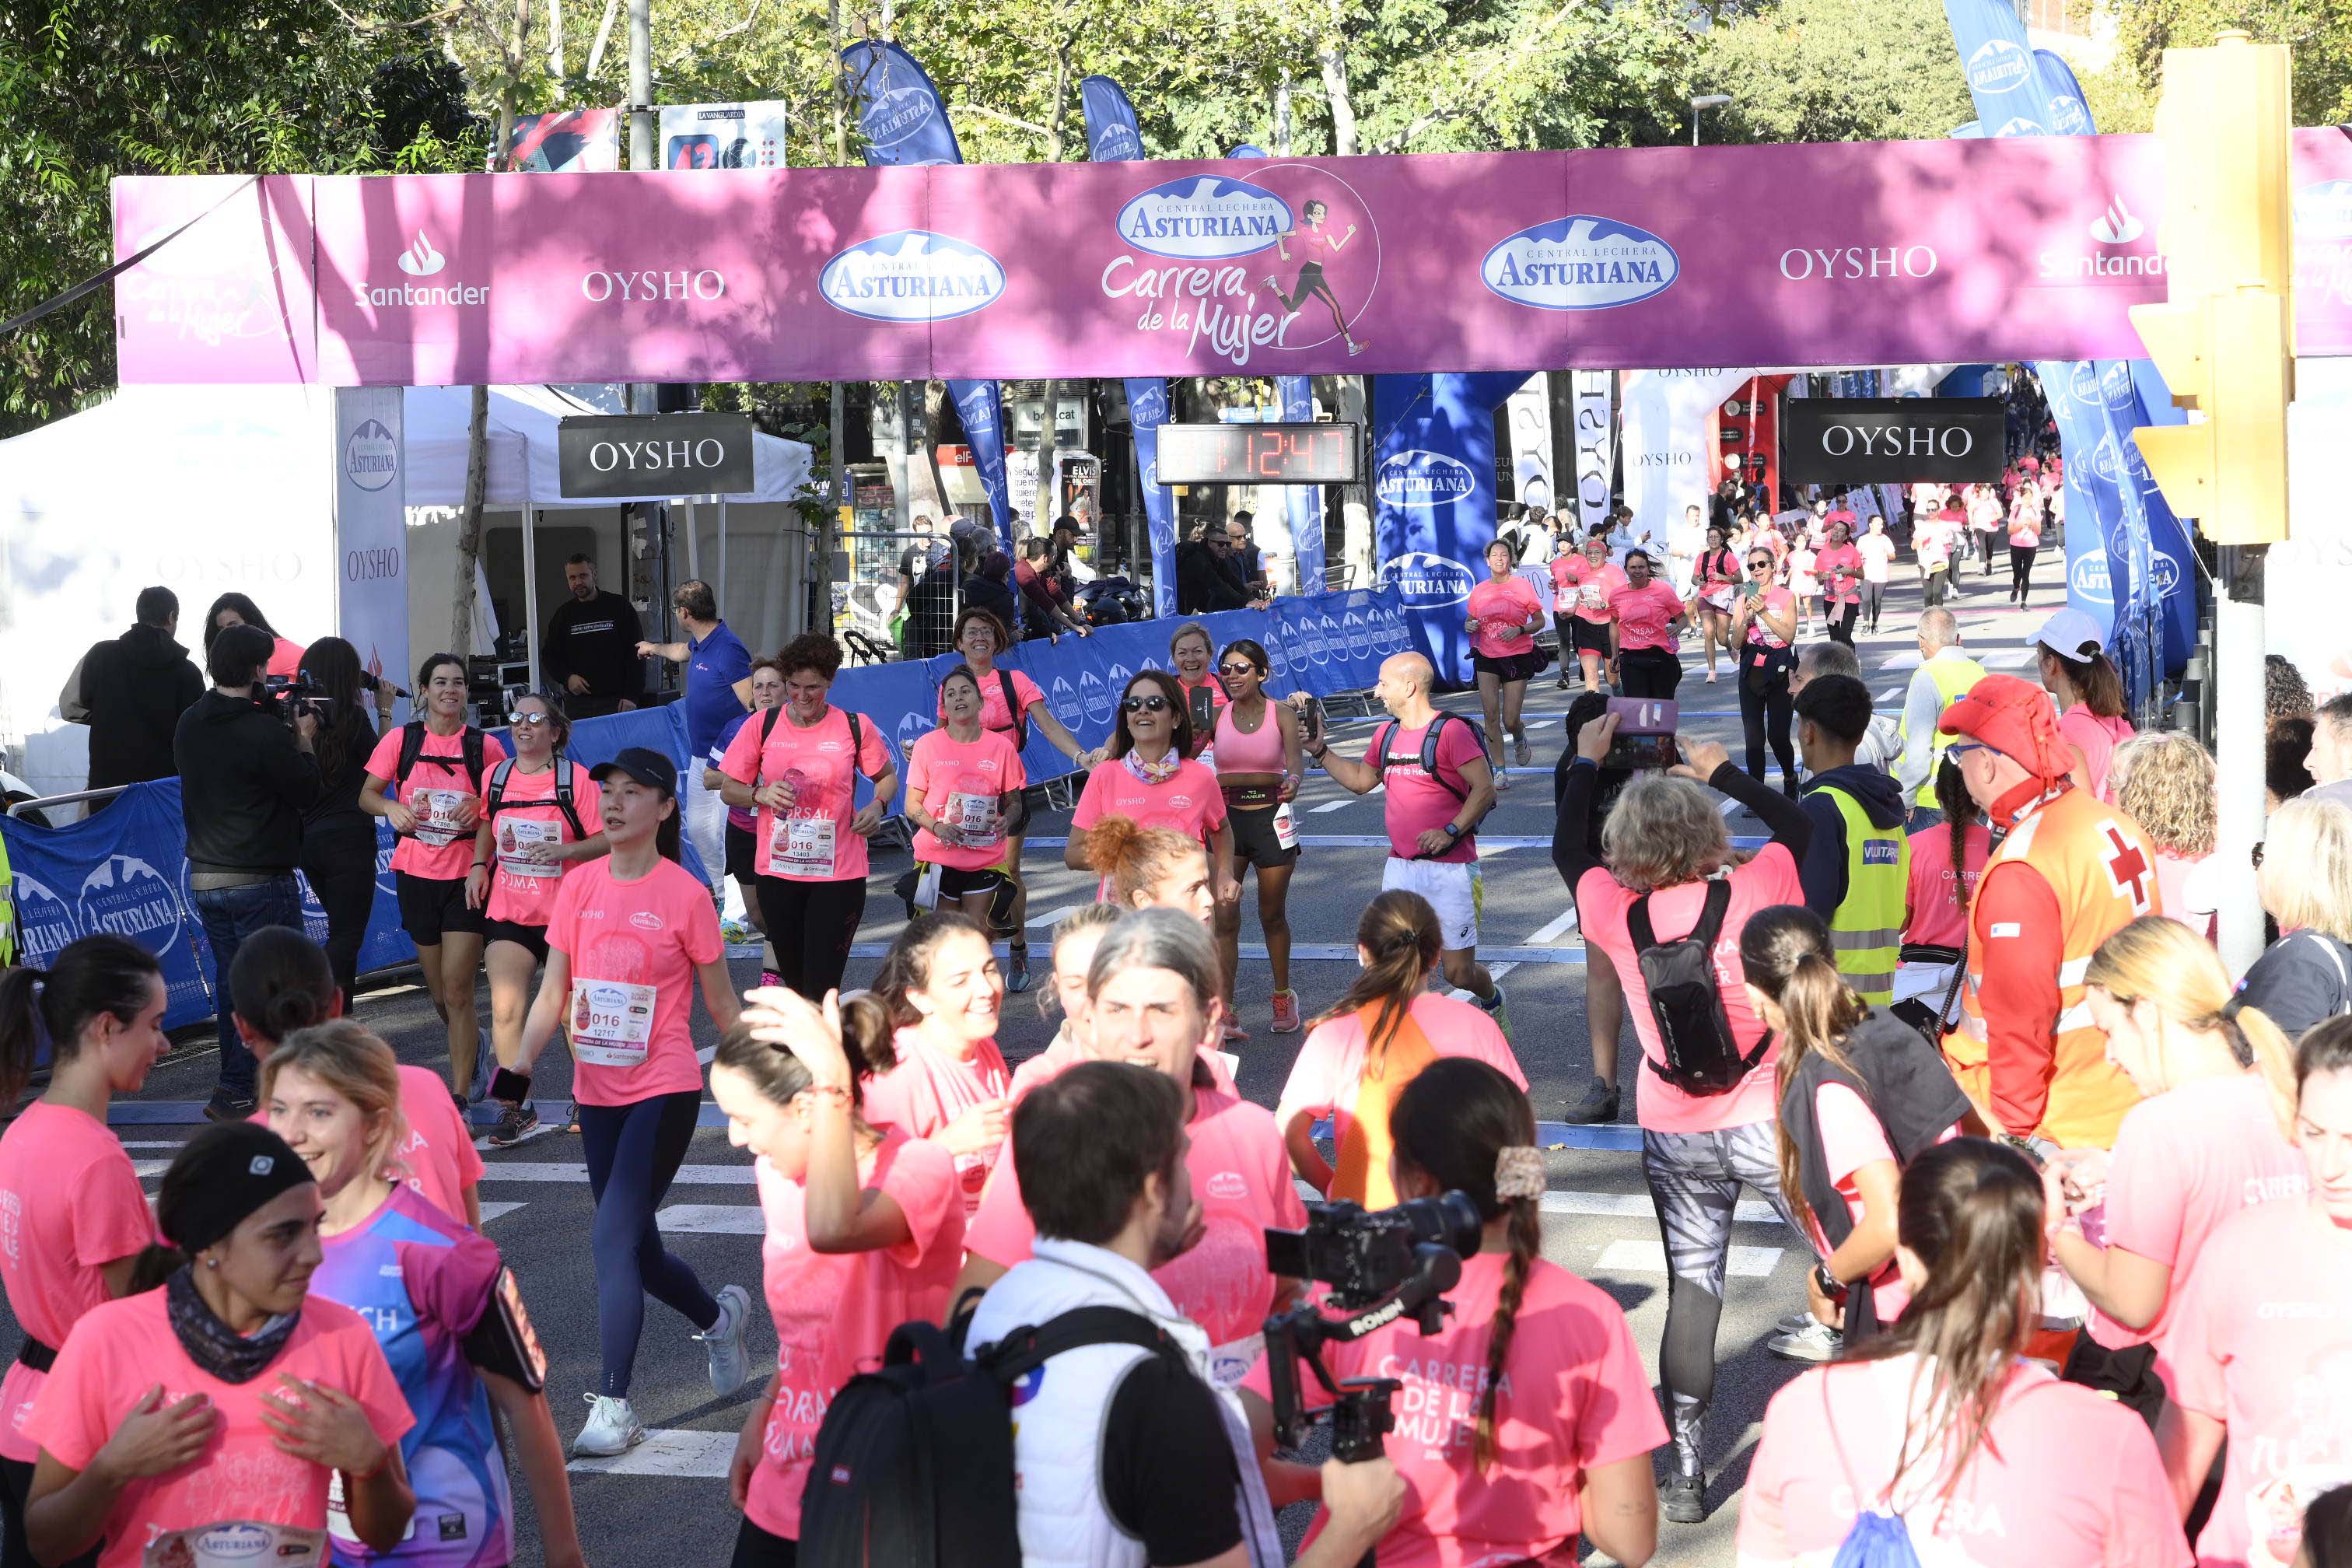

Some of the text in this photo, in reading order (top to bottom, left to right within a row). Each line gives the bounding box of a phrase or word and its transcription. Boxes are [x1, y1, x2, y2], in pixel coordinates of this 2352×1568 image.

[1129, 207, 1279, 238] ASTURIANA
[1157, 202, 1275, 214] CENTRAL LECHERA
[1526, 246, 1658, 258] CENTRAL LECHERA
[1780, 246, 1938, 280] OYSHO
[834, 264, 992, 298] ASTURIANA
[1101, 255, 1248, 298] Carrera
[1496, 251, 1664, 287] ASTURIANA
[354, 282, 490, 307] Santander
[581, 269, 725, 303] OYSHO
[1137, 292, 1301, 366] de la Mujer
[1580, 370, 1606, 508] OYSH
[1822, 425, 1973, 457] OYSHO
[349, 446, 394, 473] ASTURIANA
[590, 439, 725, 471] OYSHO
[1073, 466, 1096, 475] ELVIS
[1633, 452, 1692, 467] OYSHO
[1380, 474, 1468, 493] ASTURIANA
[347, 547, 399, 582] OYSHO
[1399, 579, 1469, 595] TURIANA
[1116, 796, 1146, 806] OYSHO
[792, 841, 813, 850] 016
[500, 871, 538, 889] SUMA
[28, 905, 61, 919] LECHERA
[96, 893, 131, 908] CENTRAL
[87, 898, 176, 936] ASTURIANA
[592, 1013, 620, 1027] 016
[594, 1028, 615, 1037] 12717
[1349, 1297, 1405, 1336] RONIN
[1378, 1354, 1513, 1398] CARRERA
[1402, 1386, 1441, 1417] DE
[1391, 1414, 1470, 1447] MUJE
